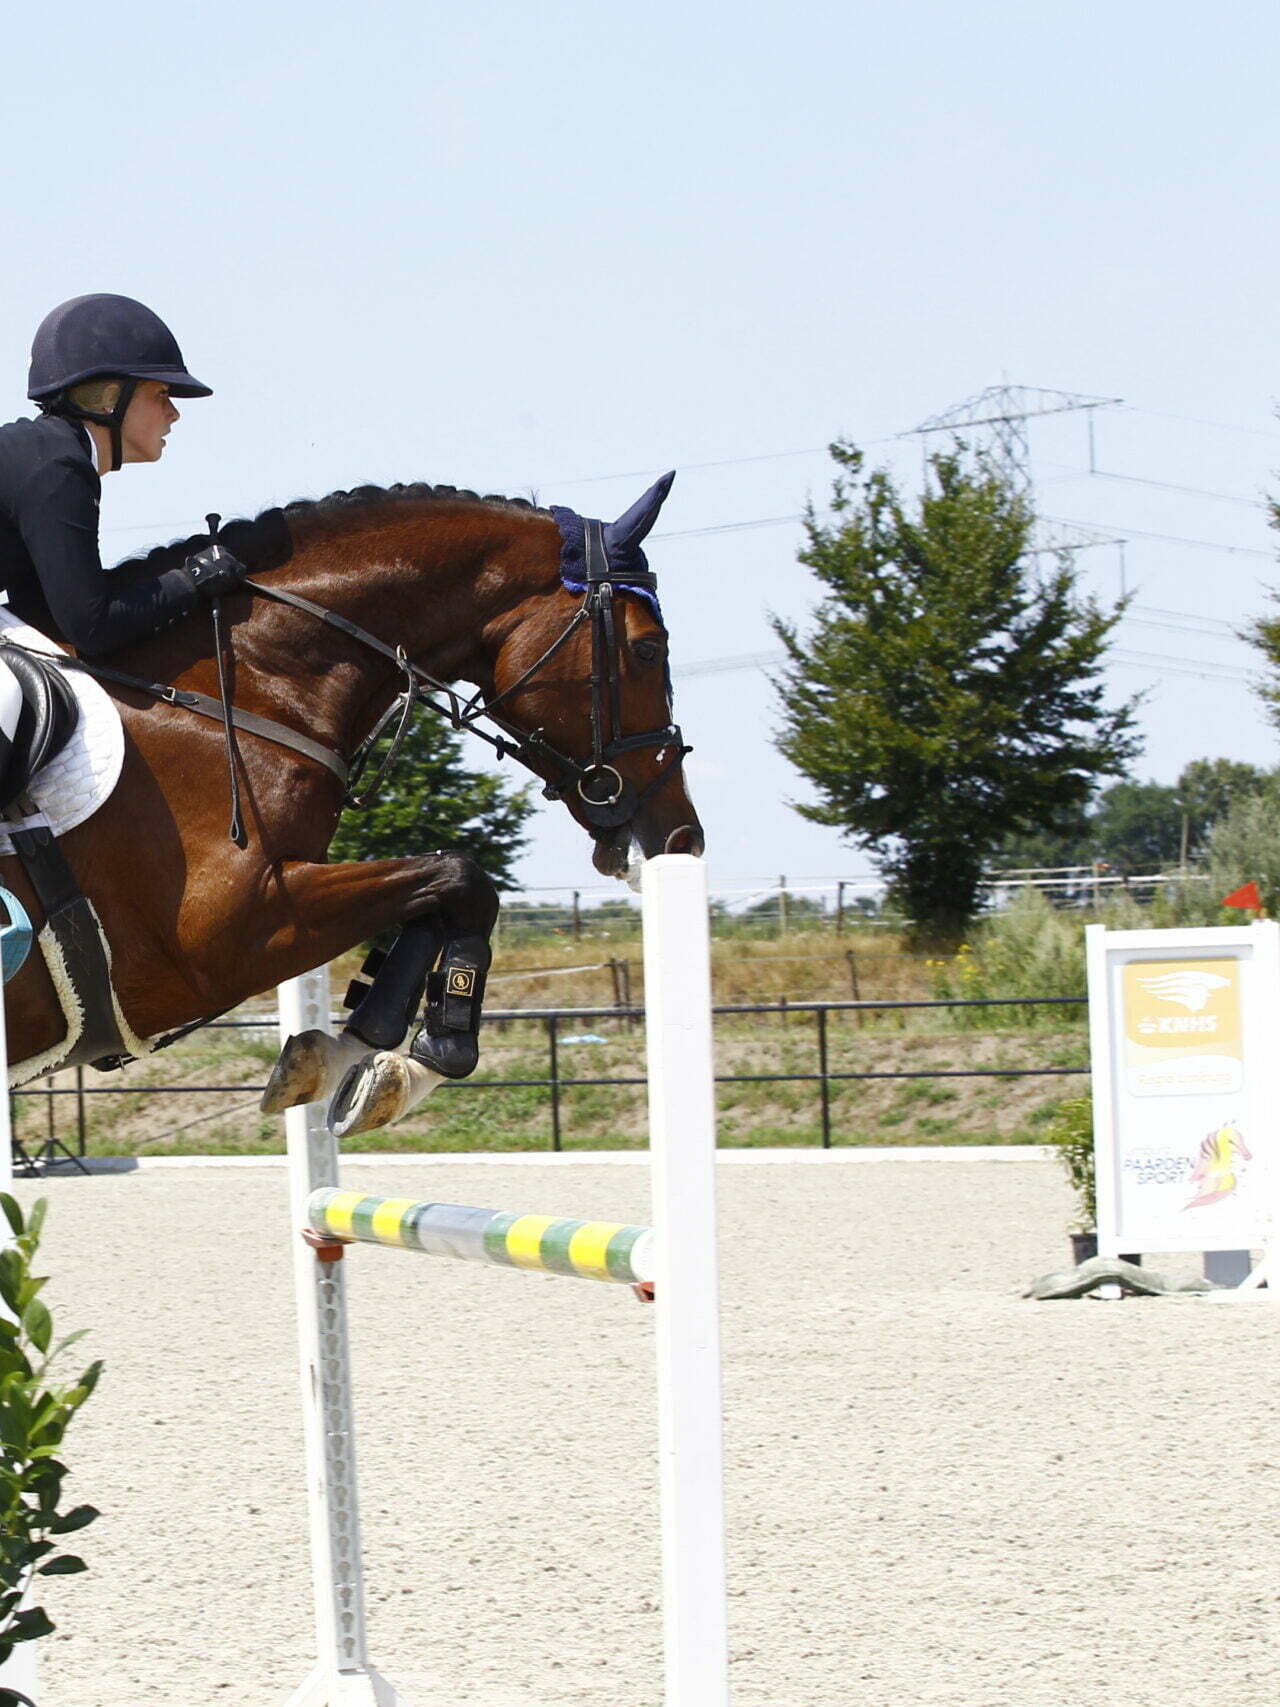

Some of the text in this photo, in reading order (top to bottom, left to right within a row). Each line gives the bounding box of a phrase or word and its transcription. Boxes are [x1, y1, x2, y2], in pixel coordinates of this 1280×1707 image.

[1157, 1015, 1217, 1033] KNHS
[1122, 1156, 1195, 1171] PAARDEN
[1136, 1170, 1186, 1185] SPORT
